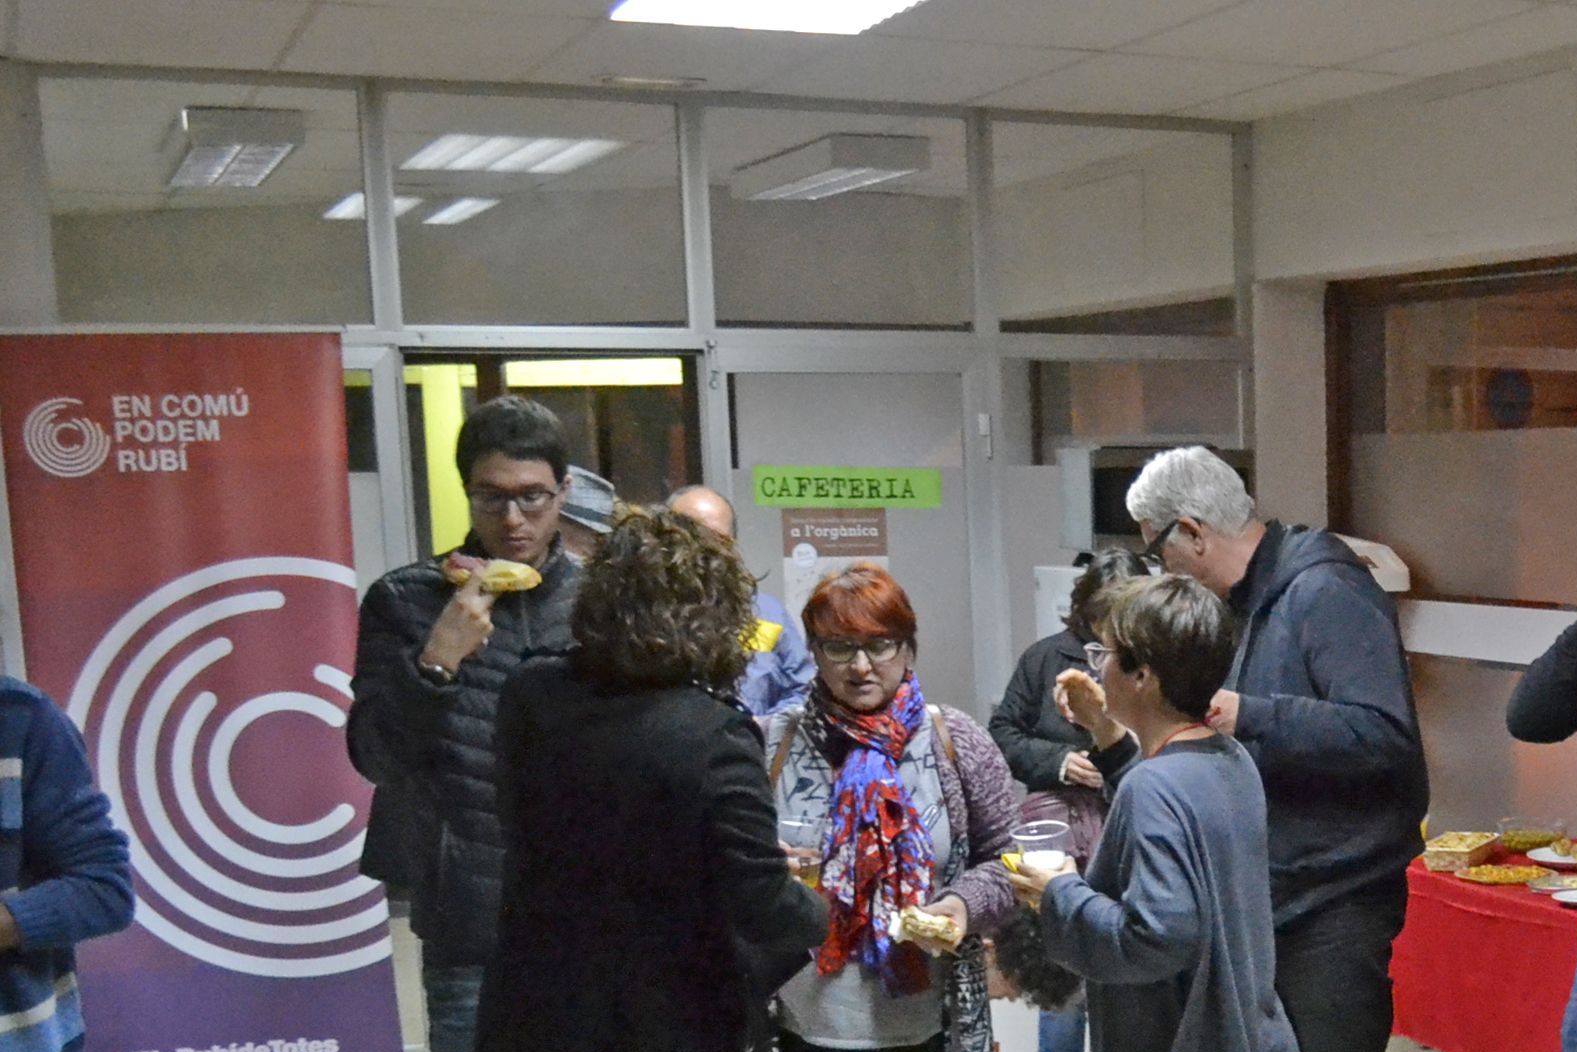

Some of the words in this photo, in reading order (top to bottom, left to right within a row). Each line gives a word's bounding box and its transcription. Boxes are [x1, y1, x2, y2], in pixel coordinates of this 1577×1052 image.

[112, 395, 152, 417] EN
[161, 387, 249, 417] COMÚ
[115, 419, 220, 442] PODEM
[118, 443, 188, 472] RUBÍ
[761, 476, 916, 499] CAFETERIA
[790, 528, 801, 537] a
